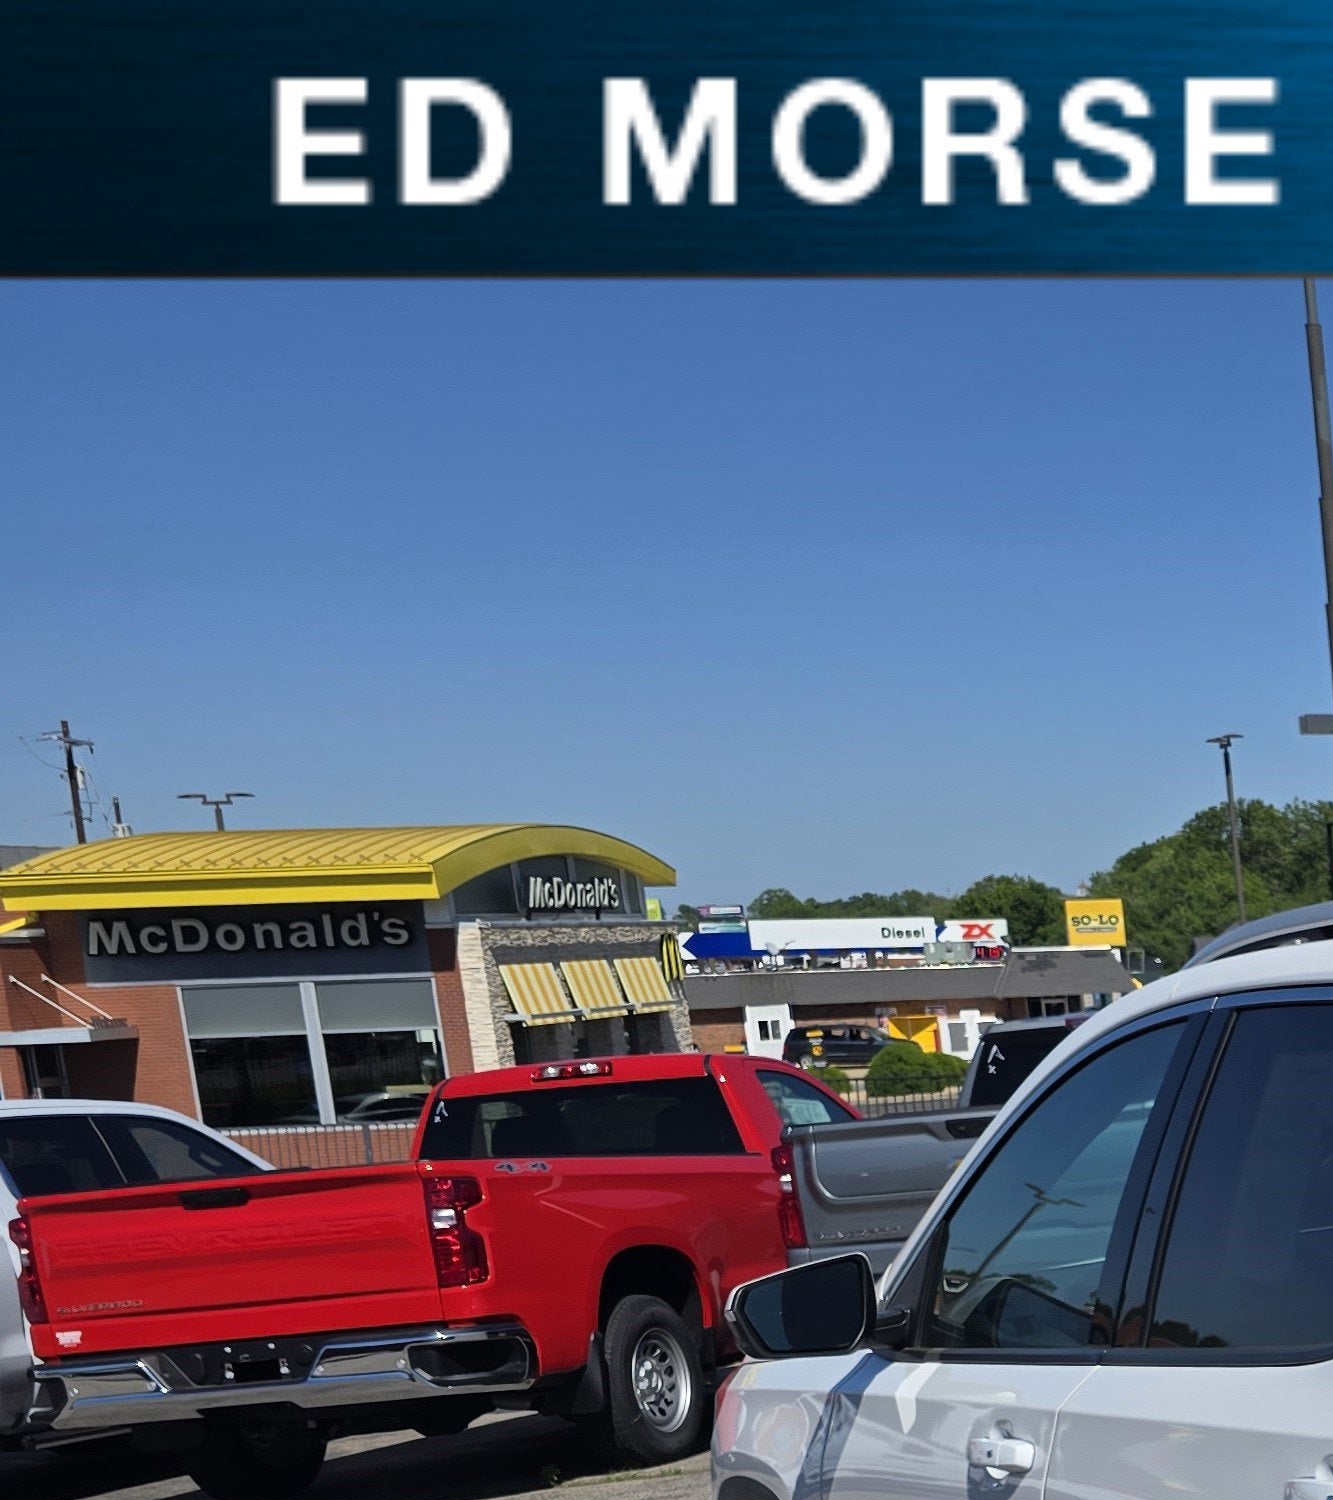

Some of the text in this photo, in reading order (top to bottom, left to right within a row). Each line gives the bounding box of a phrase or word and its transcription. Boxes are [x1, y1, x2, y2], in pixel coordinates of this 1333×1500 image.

[528, 876, 619, 909] McDonald's
[1071, 914, 1119, 927] SO-LO
[88, 911, 411, 957] McDonald's
[881, 927, 926, 939] Diesel
[959, 923, 995, 939] ZX
